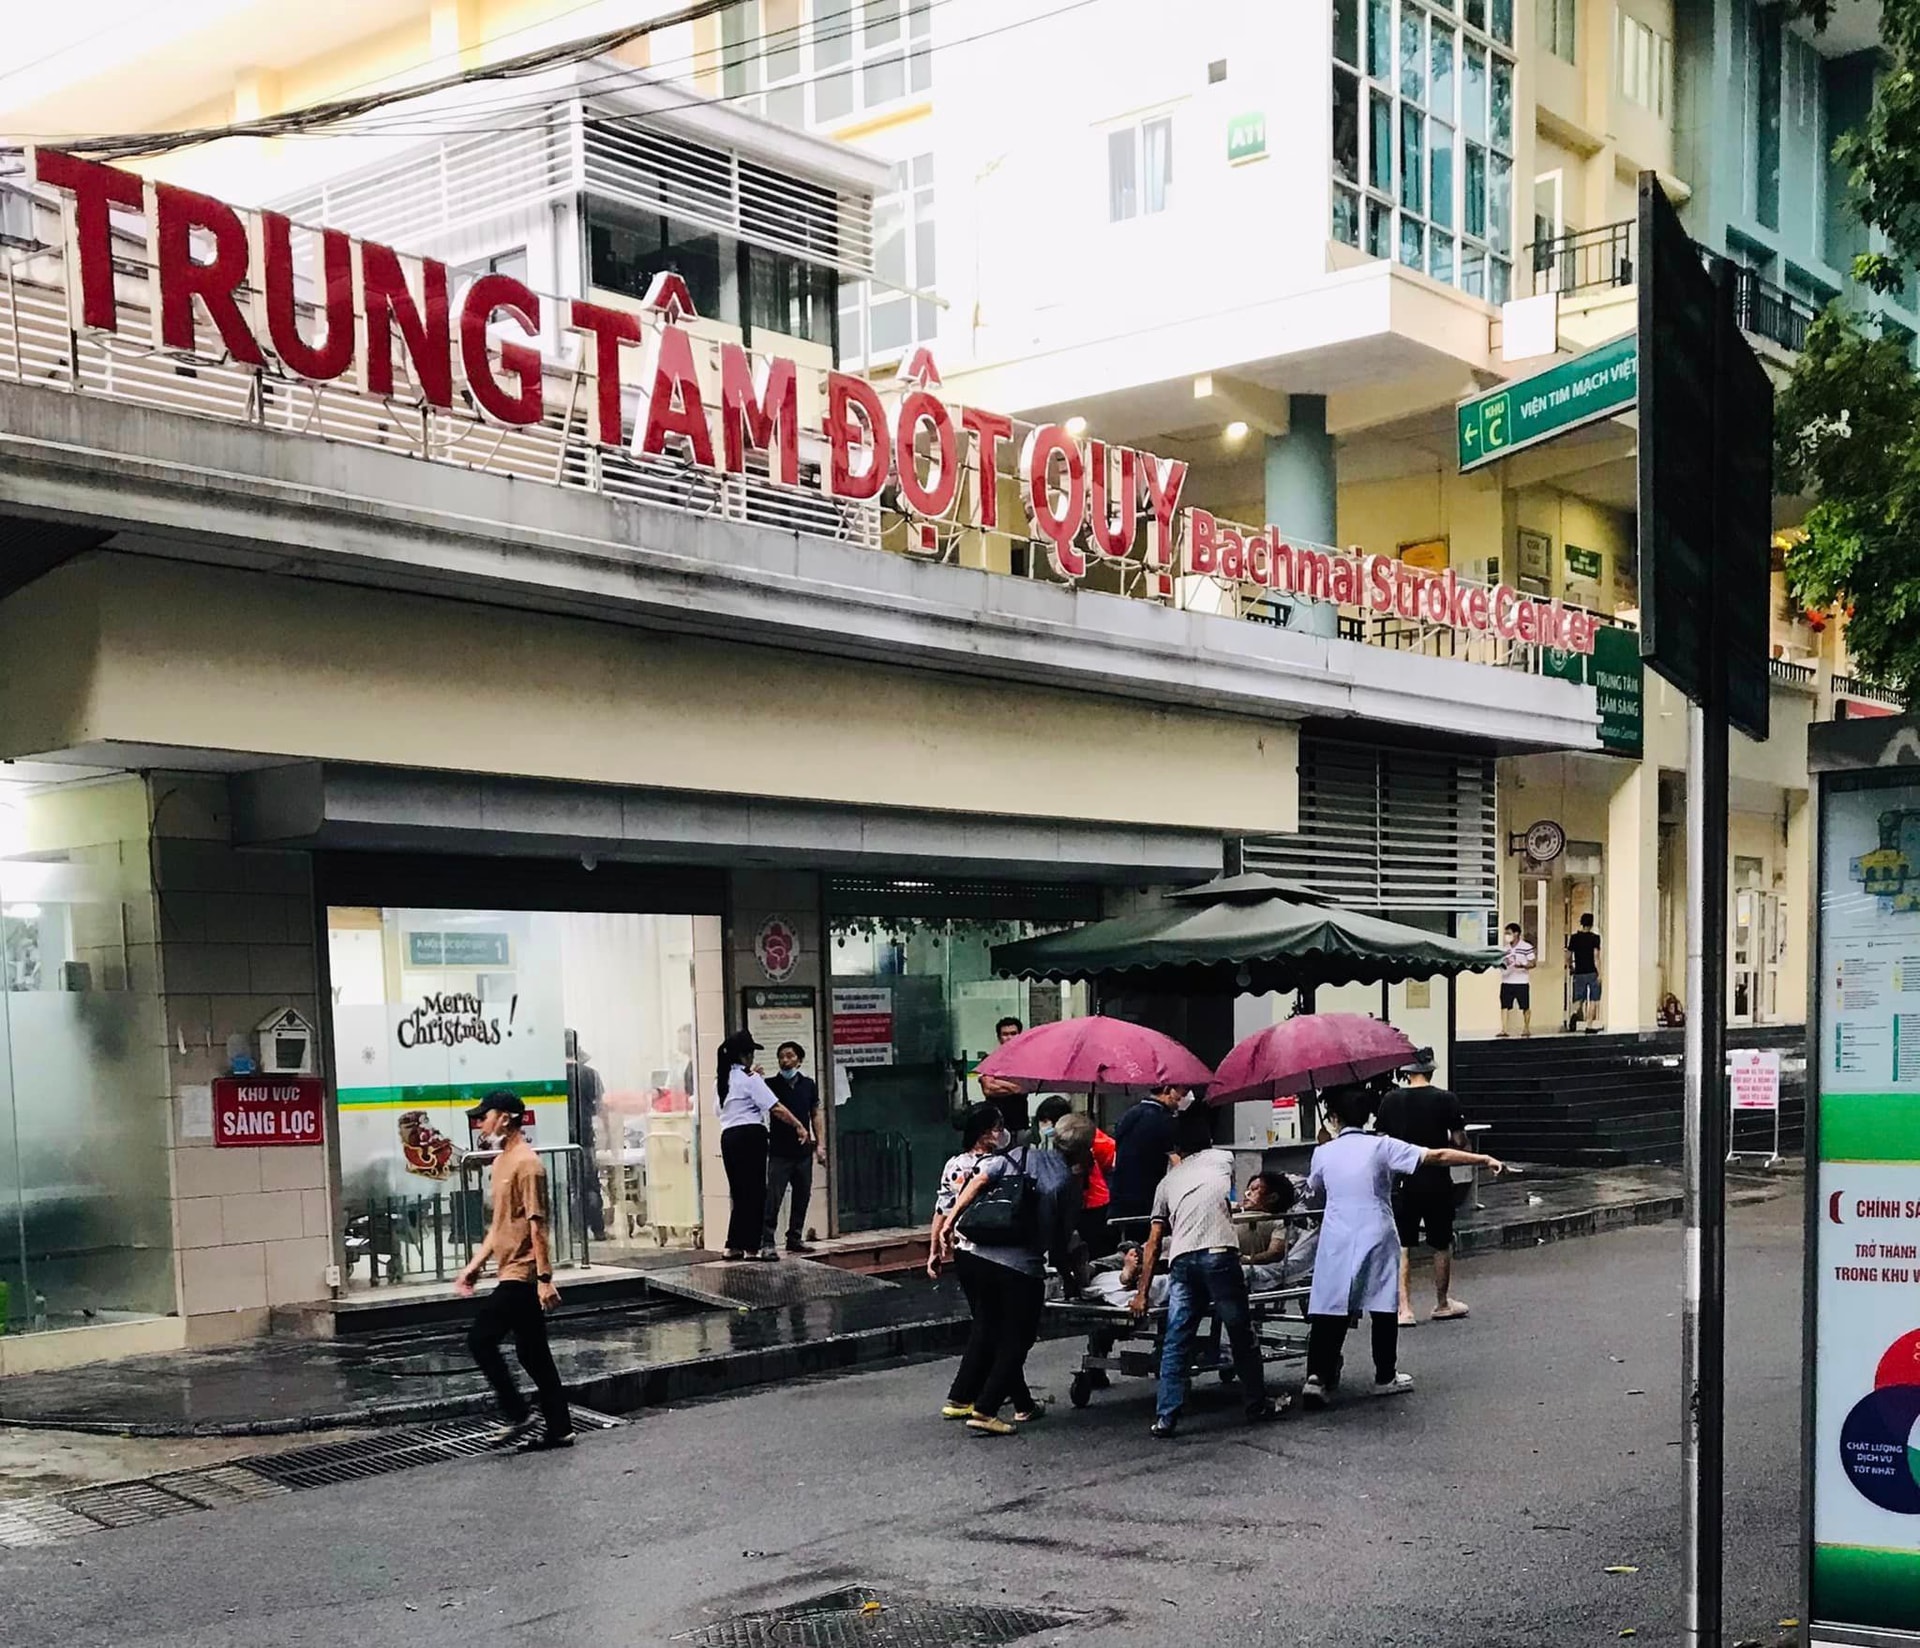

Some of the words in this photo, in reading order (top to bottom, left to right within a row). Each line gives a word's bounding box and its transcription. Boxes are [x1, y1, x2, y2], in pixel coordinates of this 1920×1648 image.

[32, 147, 543, 427] TRUNG
[570, 271, 799, 486] TÂM
[822, 347, 1014, 551] ĐỘT
[1022, 424, 1189, 596] QUỴ
[1519, 396, 1548, 419] VIỆN
[1548, 386, 1571, 405] TIM
[1572, 371, 1608, 398] MẠCH
[1484, 400, 1505, 420] KHU
[1489, 418, 1503, 446] C
[1188, 507, 1366, 607] Bachmai
[1366, 554, 1489, 631] Stroke
[1491, 584, 1600, 655] Center
[420, 992, 482, 1019] Merry
[238, 1086, 268, 1102] KHU
[272, 1086, 301, 1104] VỰC
[223, 1106, 275, 1136] SÀNG
[281, 1110, 315, 1139] LỌC
[1856, 1196, 1900, 1218] CHÍNH
[1855, 1238, 1877, 1258] TRỞ
[1835, 1266, 1877, 1282] TRONG
[1882, 1267, 1909, 1283] KHU
